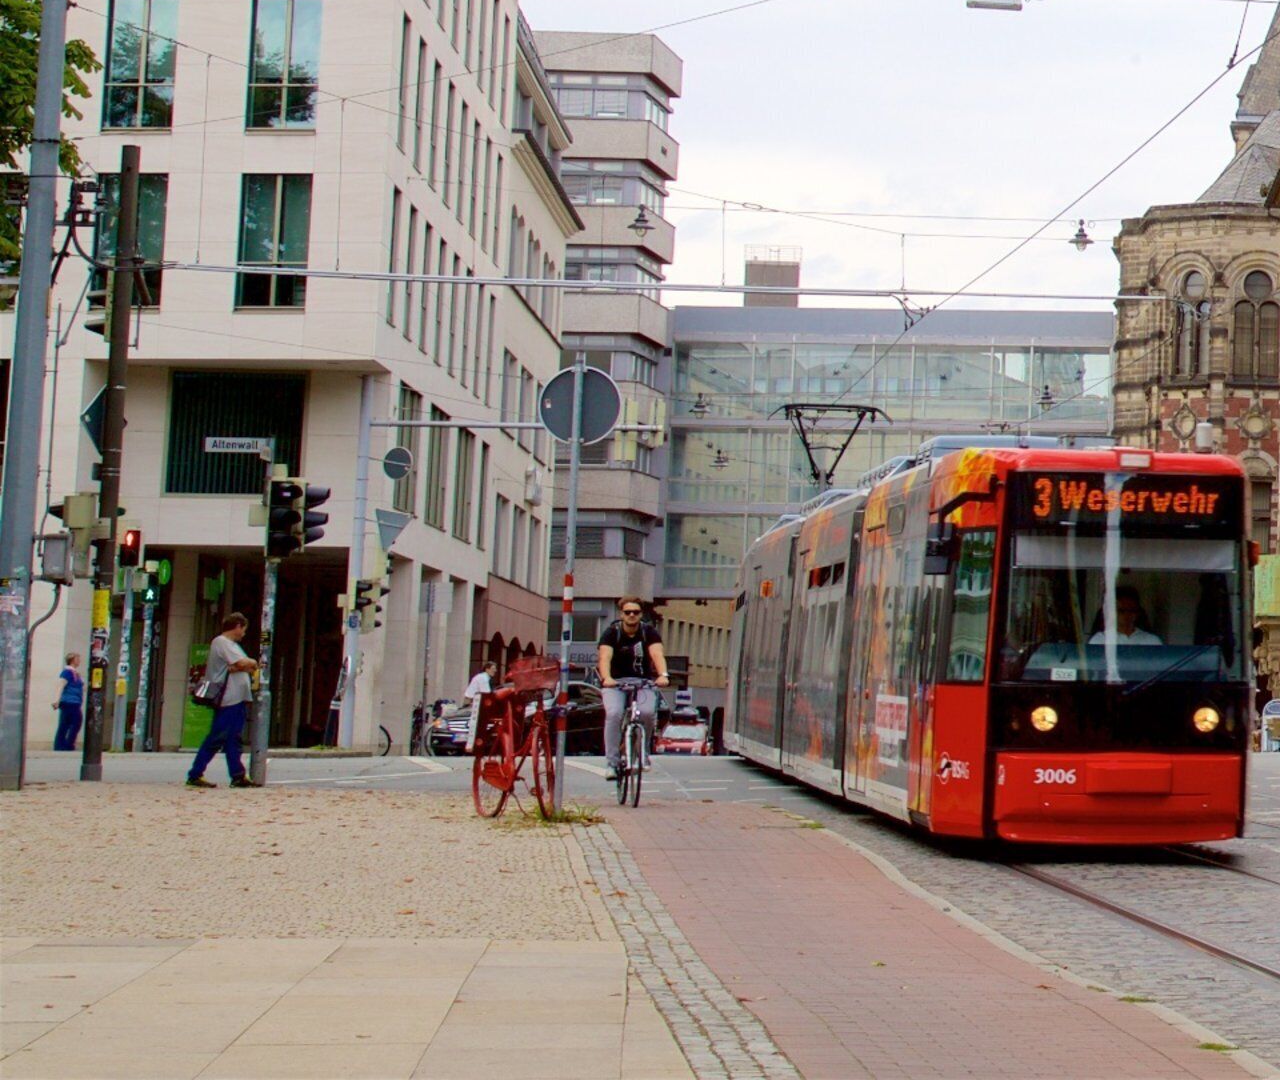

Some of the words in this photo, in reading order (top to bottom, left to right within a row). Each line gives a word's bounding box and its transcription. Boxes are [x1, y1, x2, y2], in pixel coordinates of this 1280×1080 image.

[211, 439, 258, 450] Altenwall
[1033, 477, 1053, 517] 3
[1058, 480, 1219, 514] Weserwehr
[1033, 768, 1077, 785] 3006
